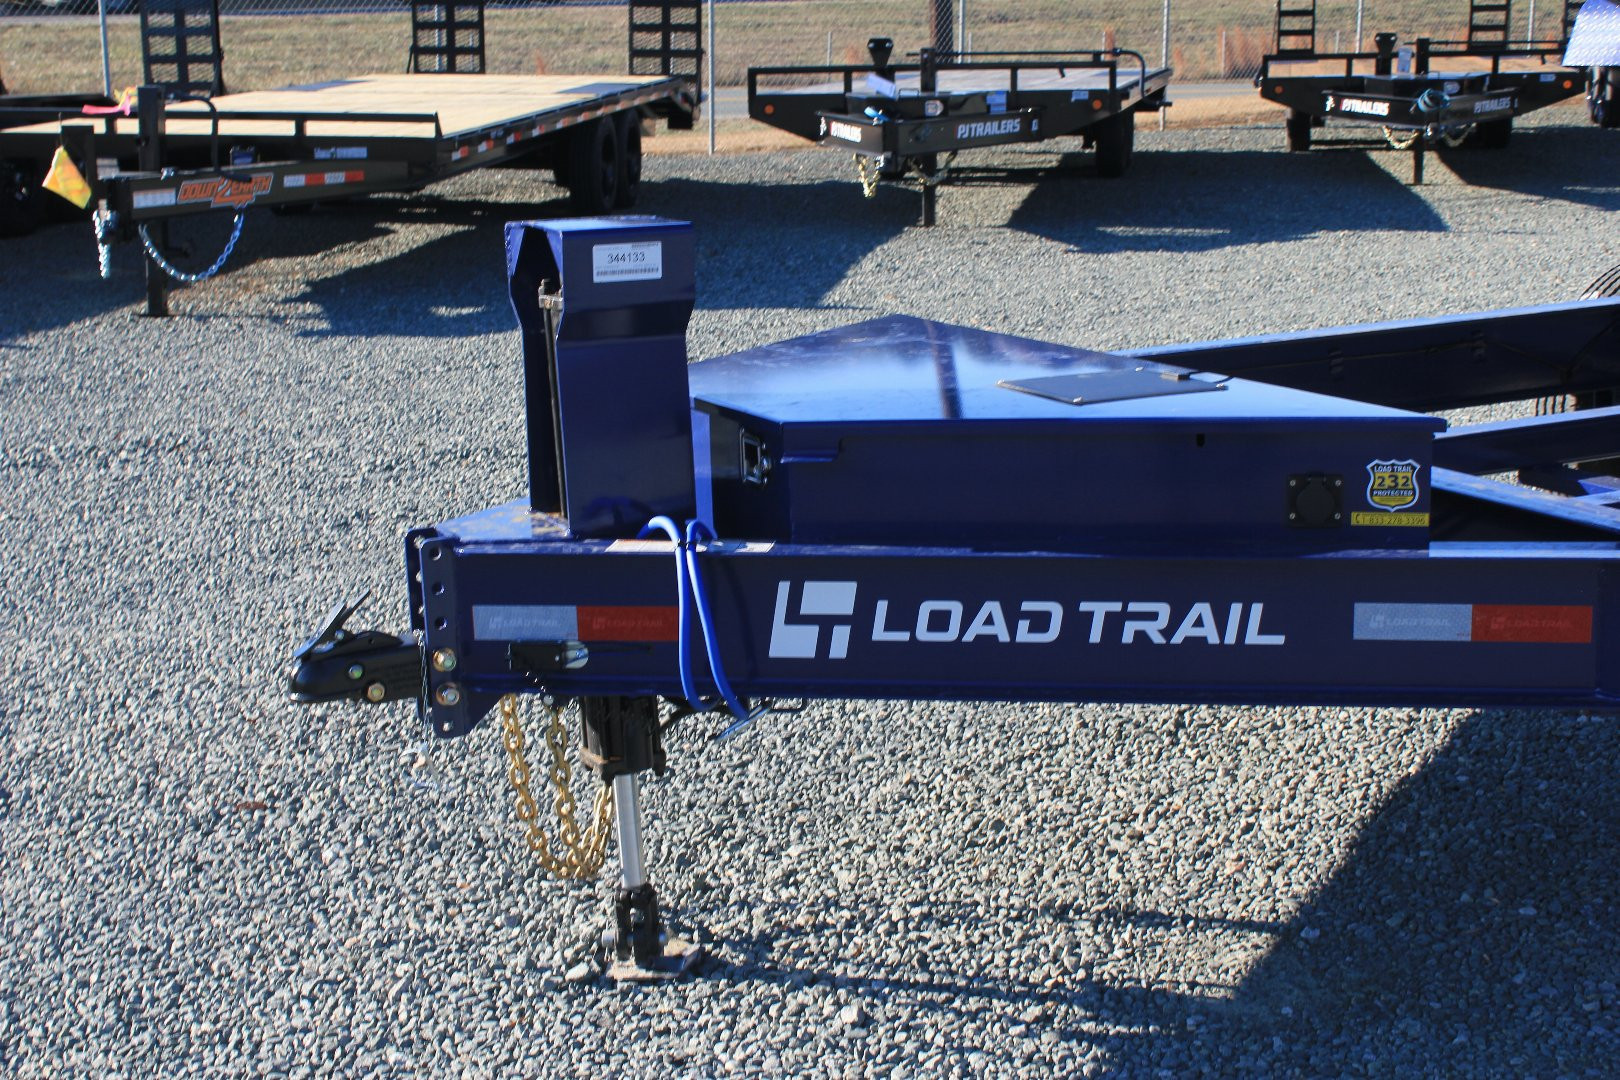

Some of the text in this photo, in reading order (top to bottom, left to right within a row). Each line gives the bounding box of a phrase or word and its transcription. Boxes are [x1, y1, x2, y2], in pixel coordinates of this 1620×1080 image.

[607, 251, 646, 264] 344133
[1374, 465, 1413, 473] LOAD TRAIL
[1376, 474, 1411, 489] 232
[1373, 489, 1414, 497] PROTECTED
[871, 600, 1064, 643] LOAD
[1078, 601, 1286, 645] TRAIL
